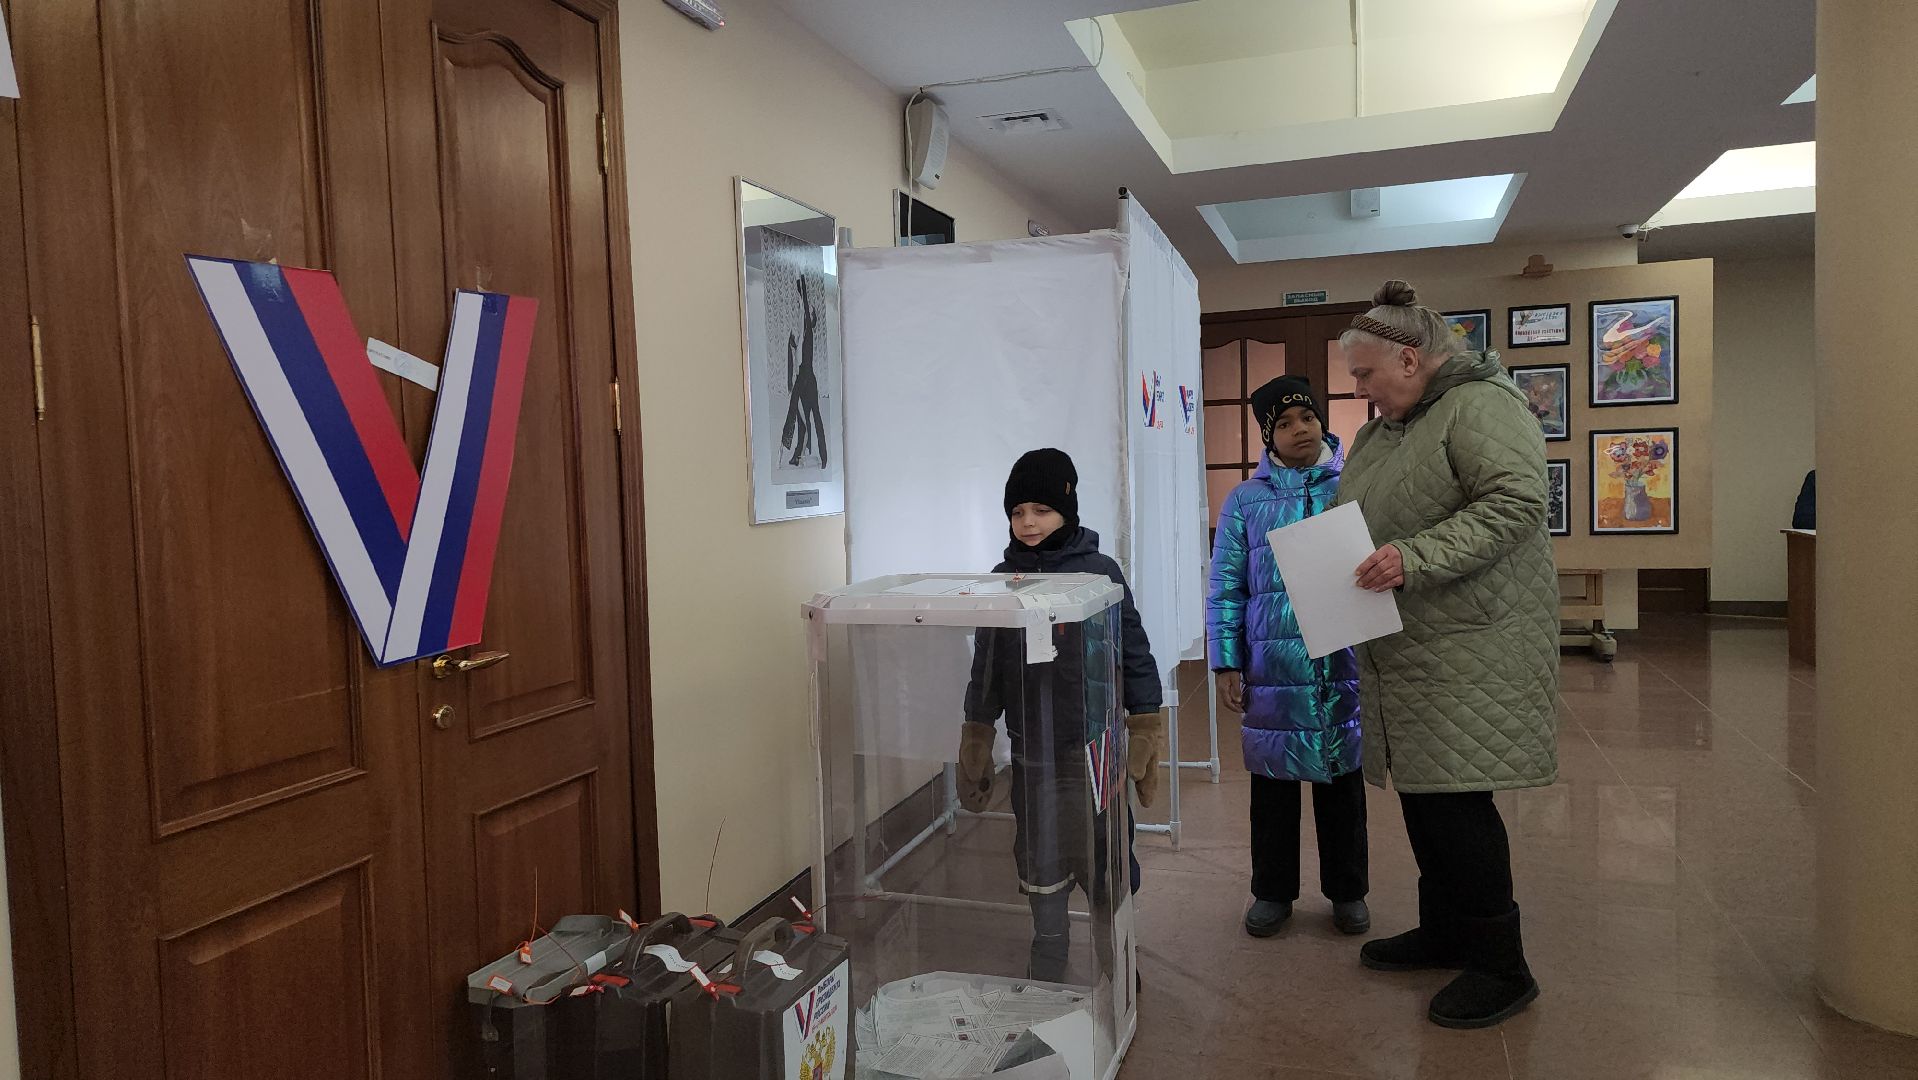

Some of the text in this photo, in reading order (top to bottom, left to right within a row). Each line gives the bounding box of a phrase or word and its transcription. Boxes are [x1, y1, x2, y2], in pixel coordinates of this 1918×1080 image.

[183, 253, 539, 668] V
[1262, 393, 1312, 442] Girls can
